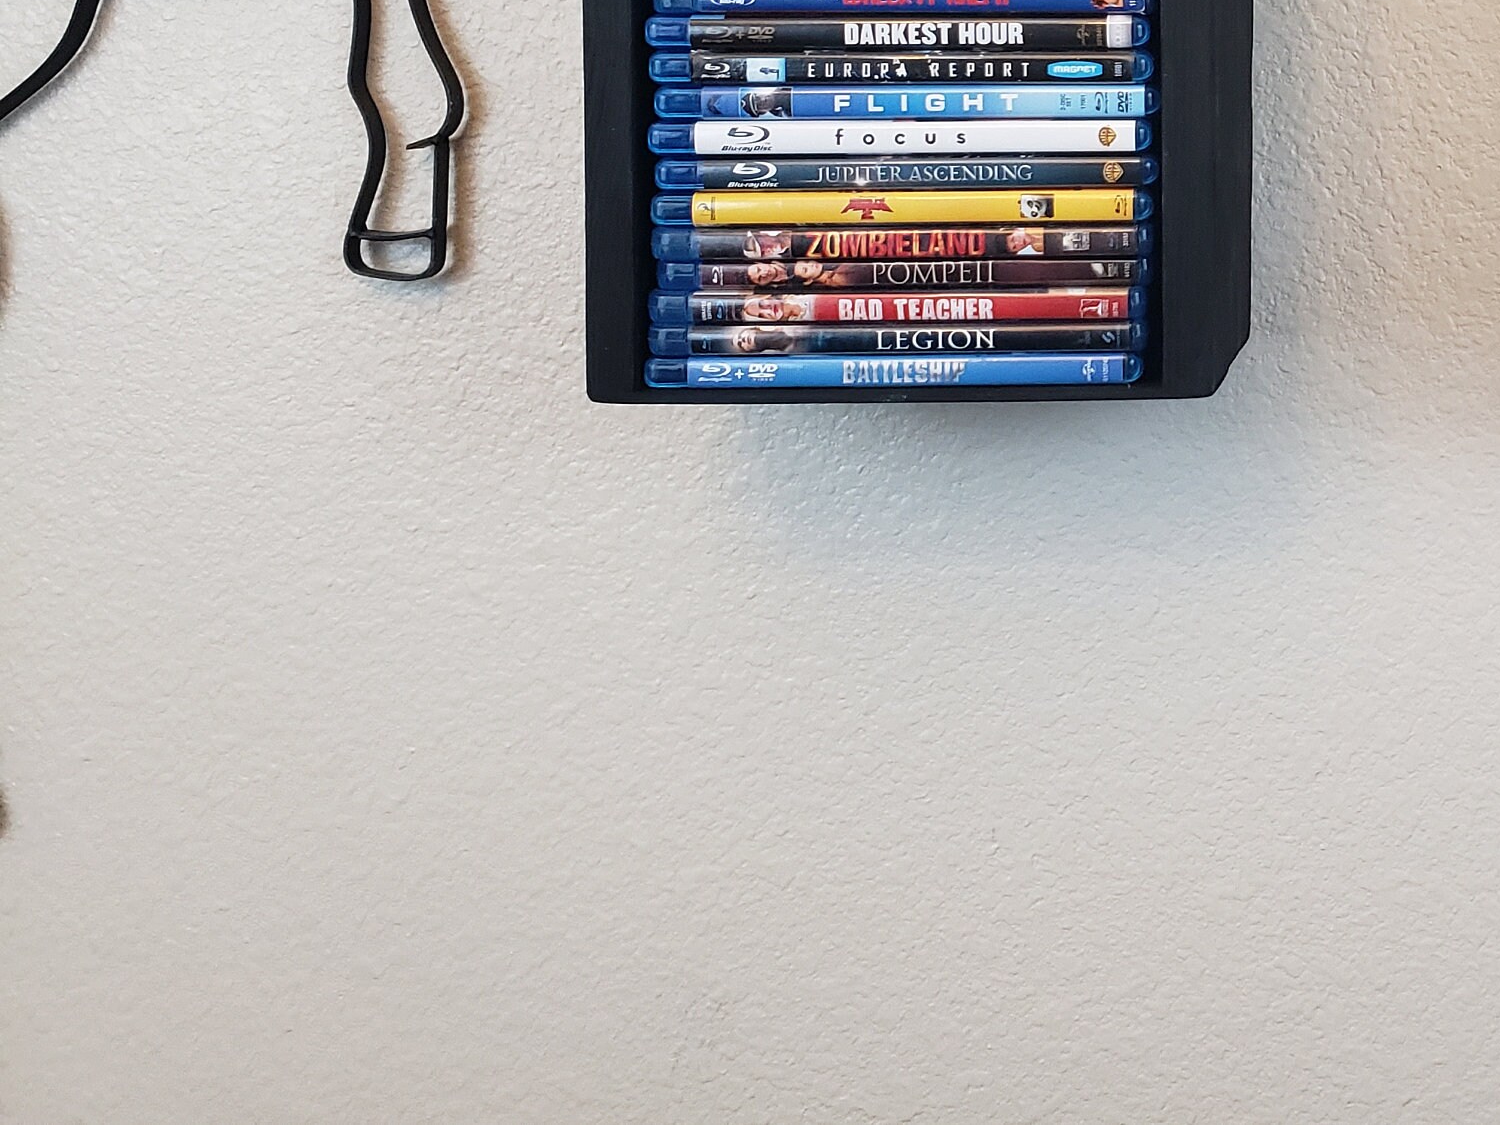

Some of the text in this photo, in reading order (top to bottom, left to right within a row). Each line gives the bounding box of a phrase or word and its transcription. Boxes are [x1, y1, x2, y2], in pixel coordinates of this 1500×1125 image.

[844, 22, 1024, 45] DARKEST HOUR
[807, 61, 1030, 79] EUROPA REPORT
[833, 94, 1019, 112] FLIGHT
[835, 128, 967, 146] focus
[816, 164, 1033, 183] JUPITER ASCENDING
[805, 230, 987, 258] ZOMBIELAND
[872, 260, 994, 285] POMPEII
[838, 298, 994, 321] BAD TEACHER
[874, 329, 997, 350] LEGION
[748, 363, 778, 373] DVD
